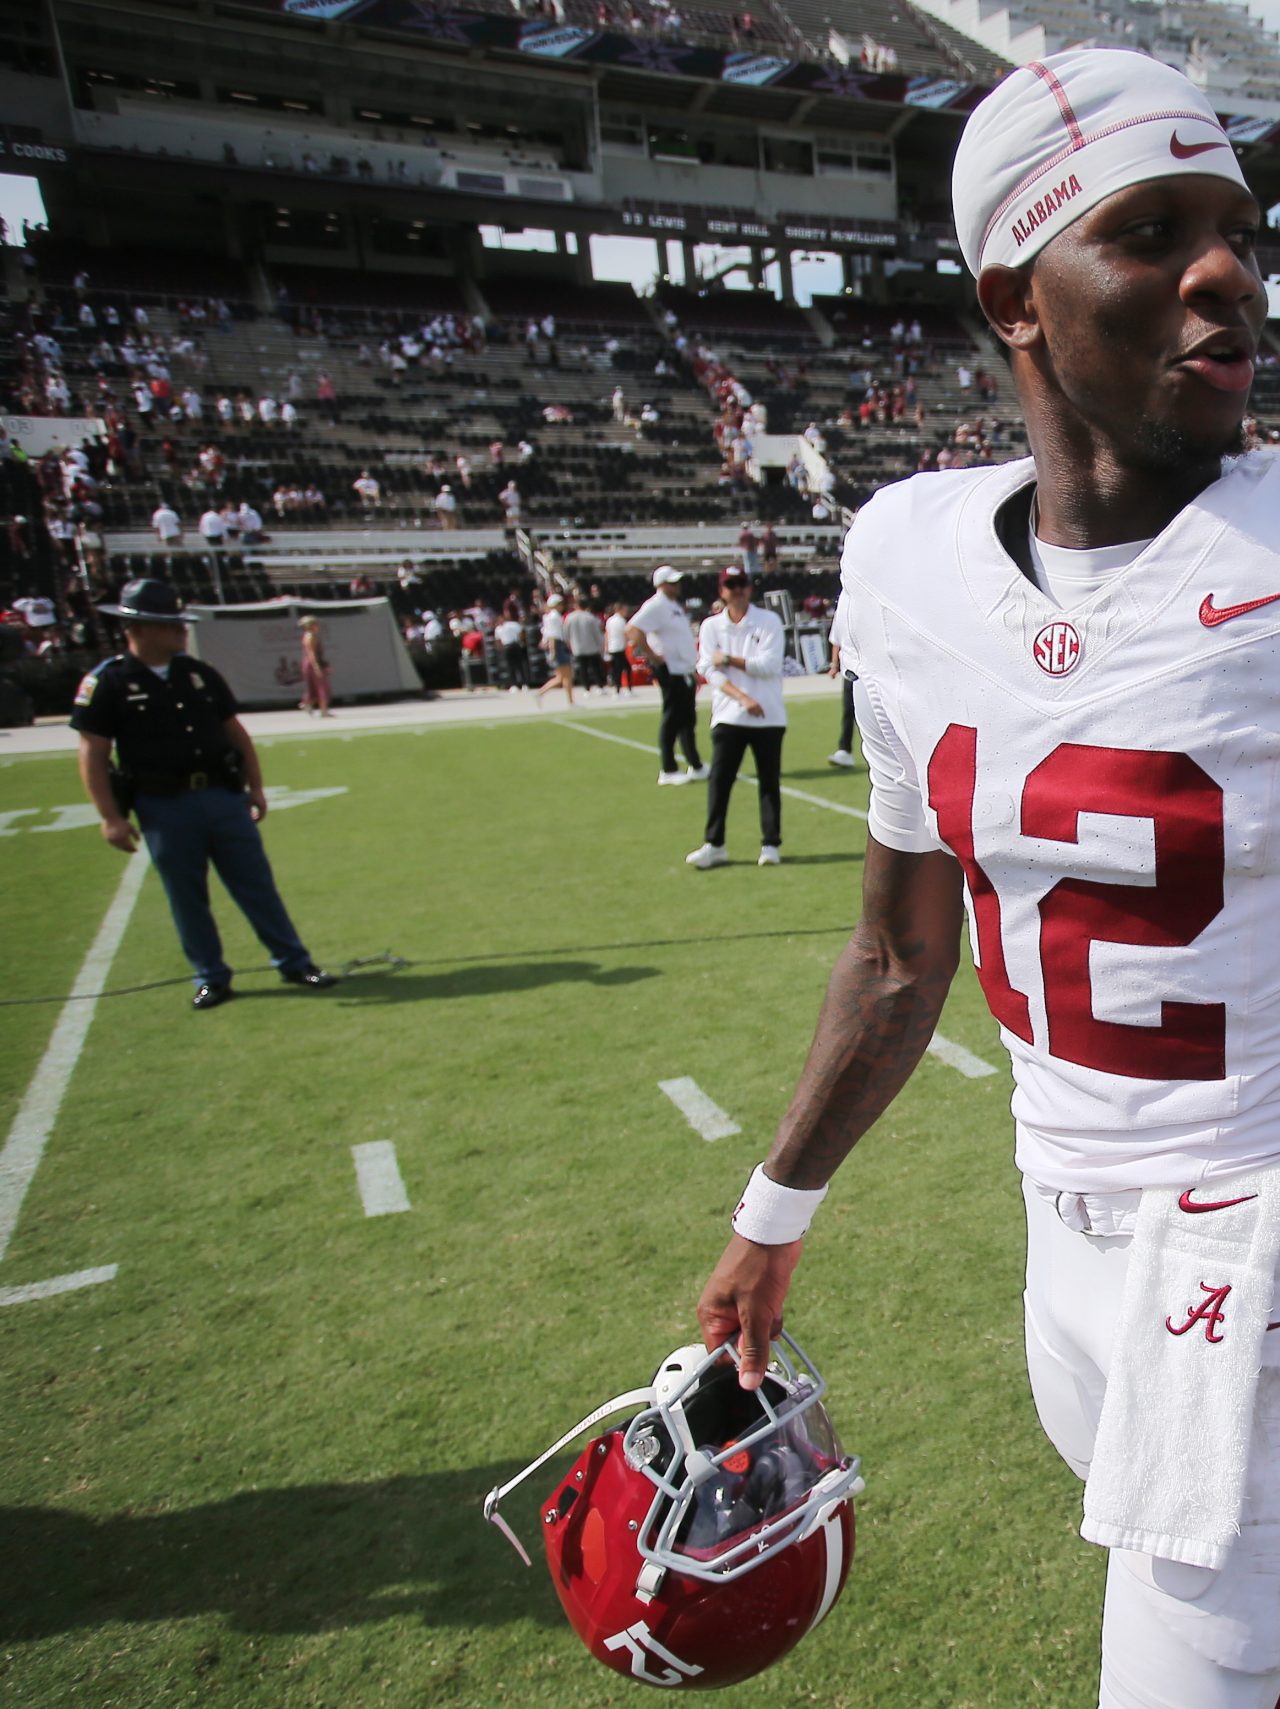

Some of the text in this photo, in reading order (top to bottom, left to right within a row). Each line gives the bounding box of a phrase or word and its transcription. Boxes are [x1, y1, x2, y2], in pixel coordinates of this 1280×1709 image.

[12, 142, 67, 162] COOKS
[649, 215, 687, 231] LEWIS
[1011, 174, 1083, 247] ALABAMA
[1035, 624, 1079, 673] SEC
[927, 723, 1226, 1080] 12
[1165, 1281, 1233, 1344] A
[603, 1619, 705, 1686] 12
